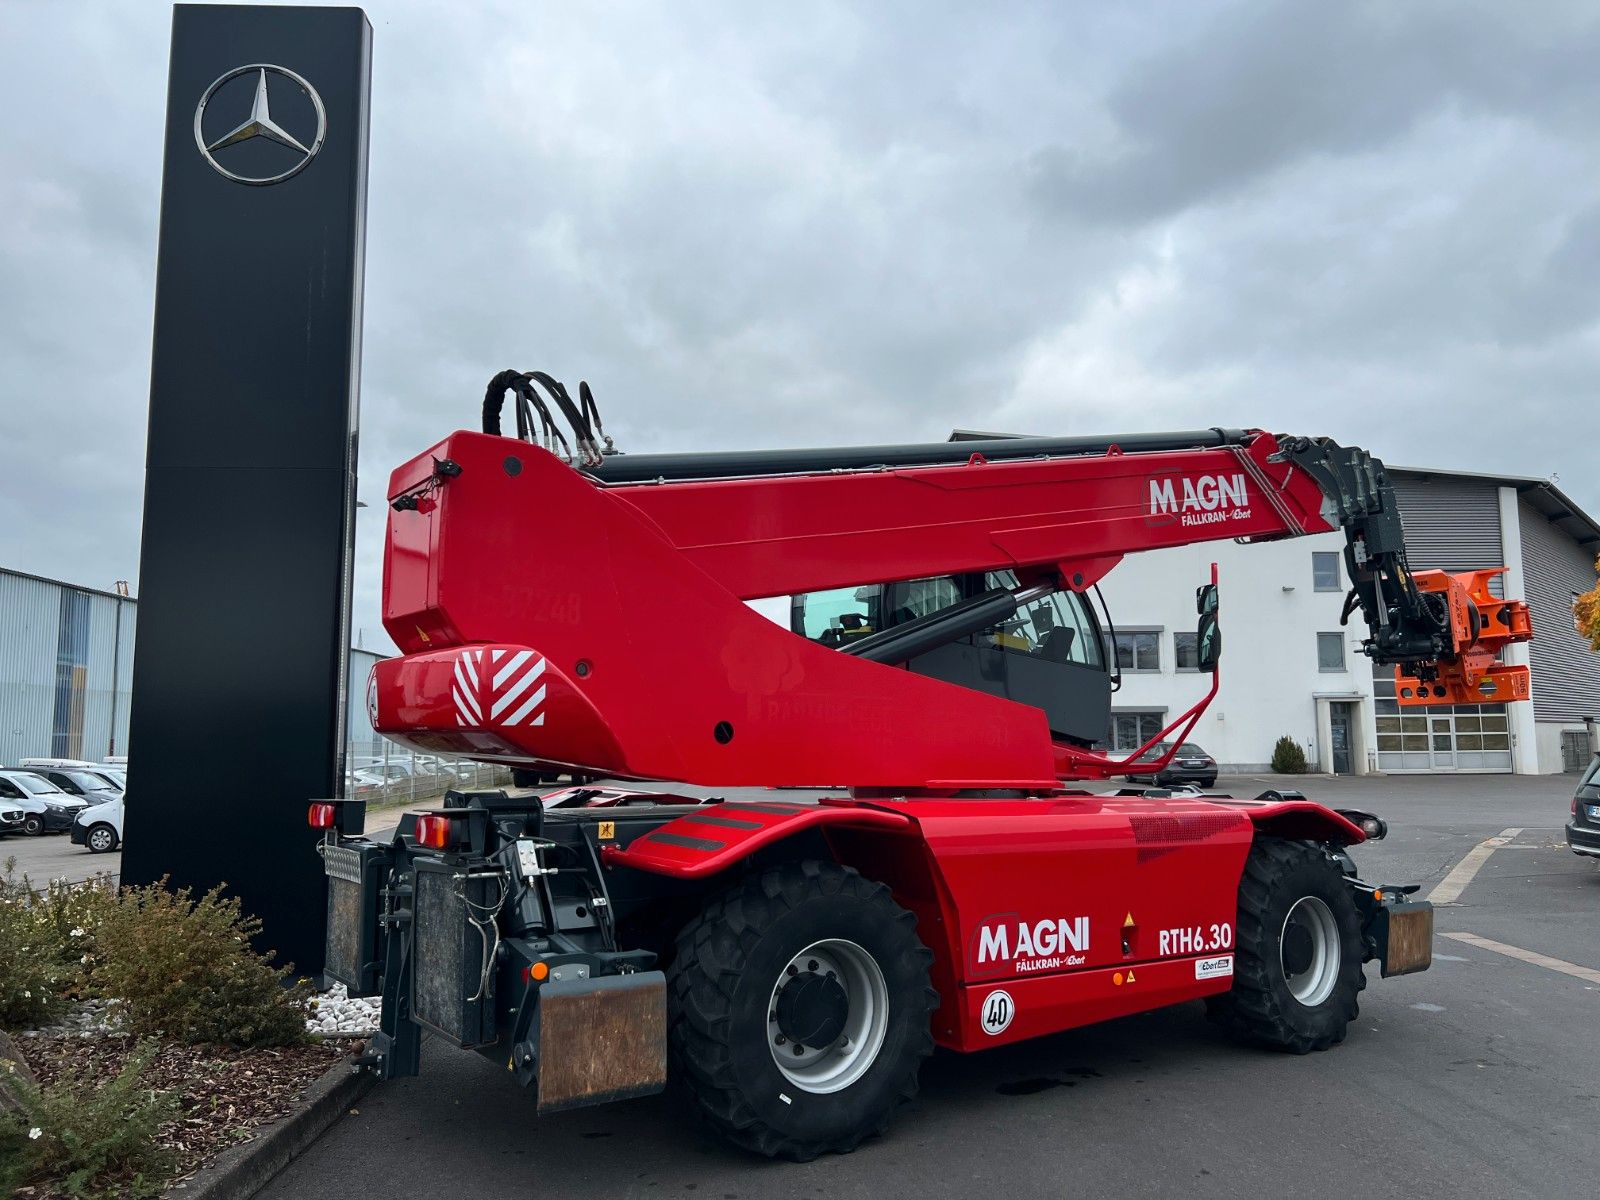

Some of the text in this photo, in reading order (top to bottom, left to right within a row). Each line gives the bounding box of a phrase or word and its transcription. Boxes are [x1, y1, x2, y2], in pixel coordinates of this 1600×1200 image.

[1149, 474, 1248, 514] MAGNI
[978, 916, 1090, 963] MAGNI
[1159, 922, 1232, 956] RTH6.30
[987, 998, 1008, 1027] 40
